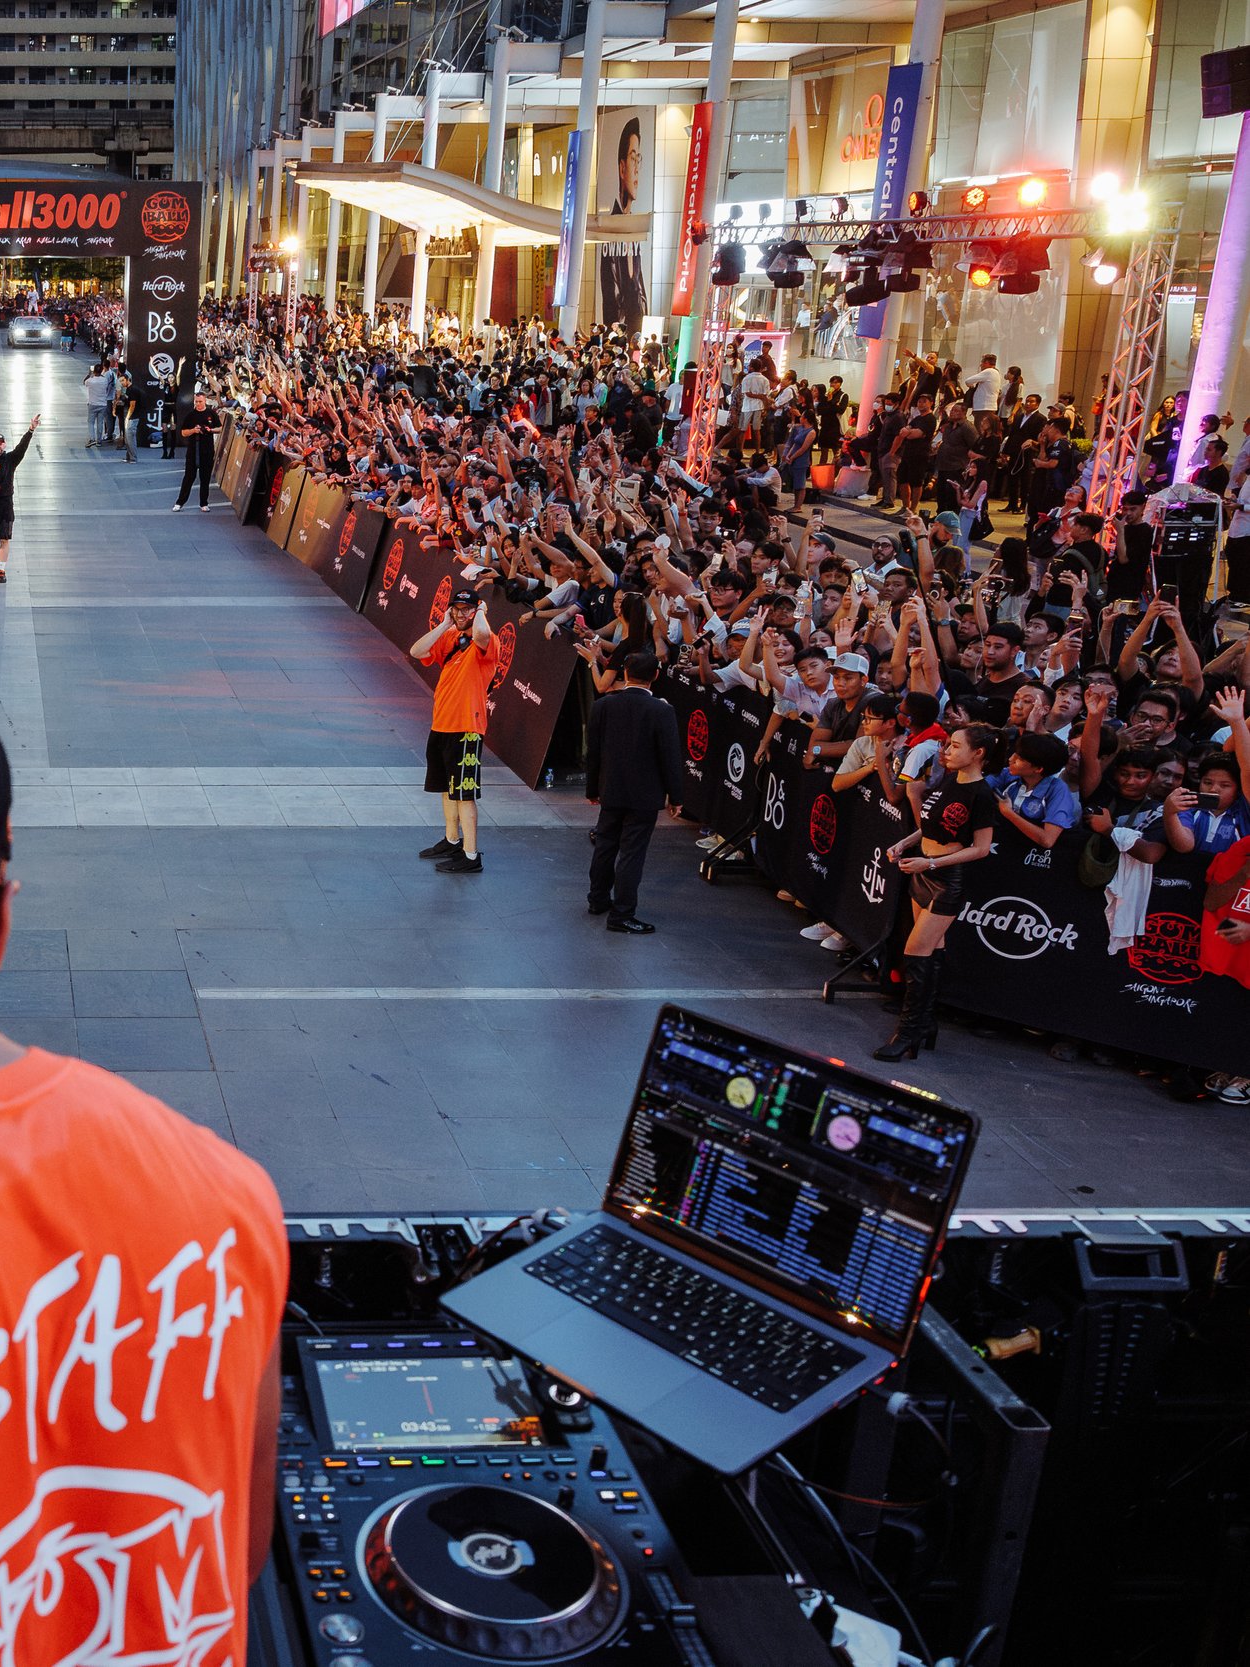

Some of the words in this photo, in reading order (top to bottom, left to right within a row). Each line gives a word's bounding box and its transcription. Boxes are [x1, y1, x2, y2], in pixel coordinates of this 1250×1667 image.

[142, 281, 165, 291] Hard
[164, 281, 185, 293] Rock
[1014, 915, 1079, 951] Rock
